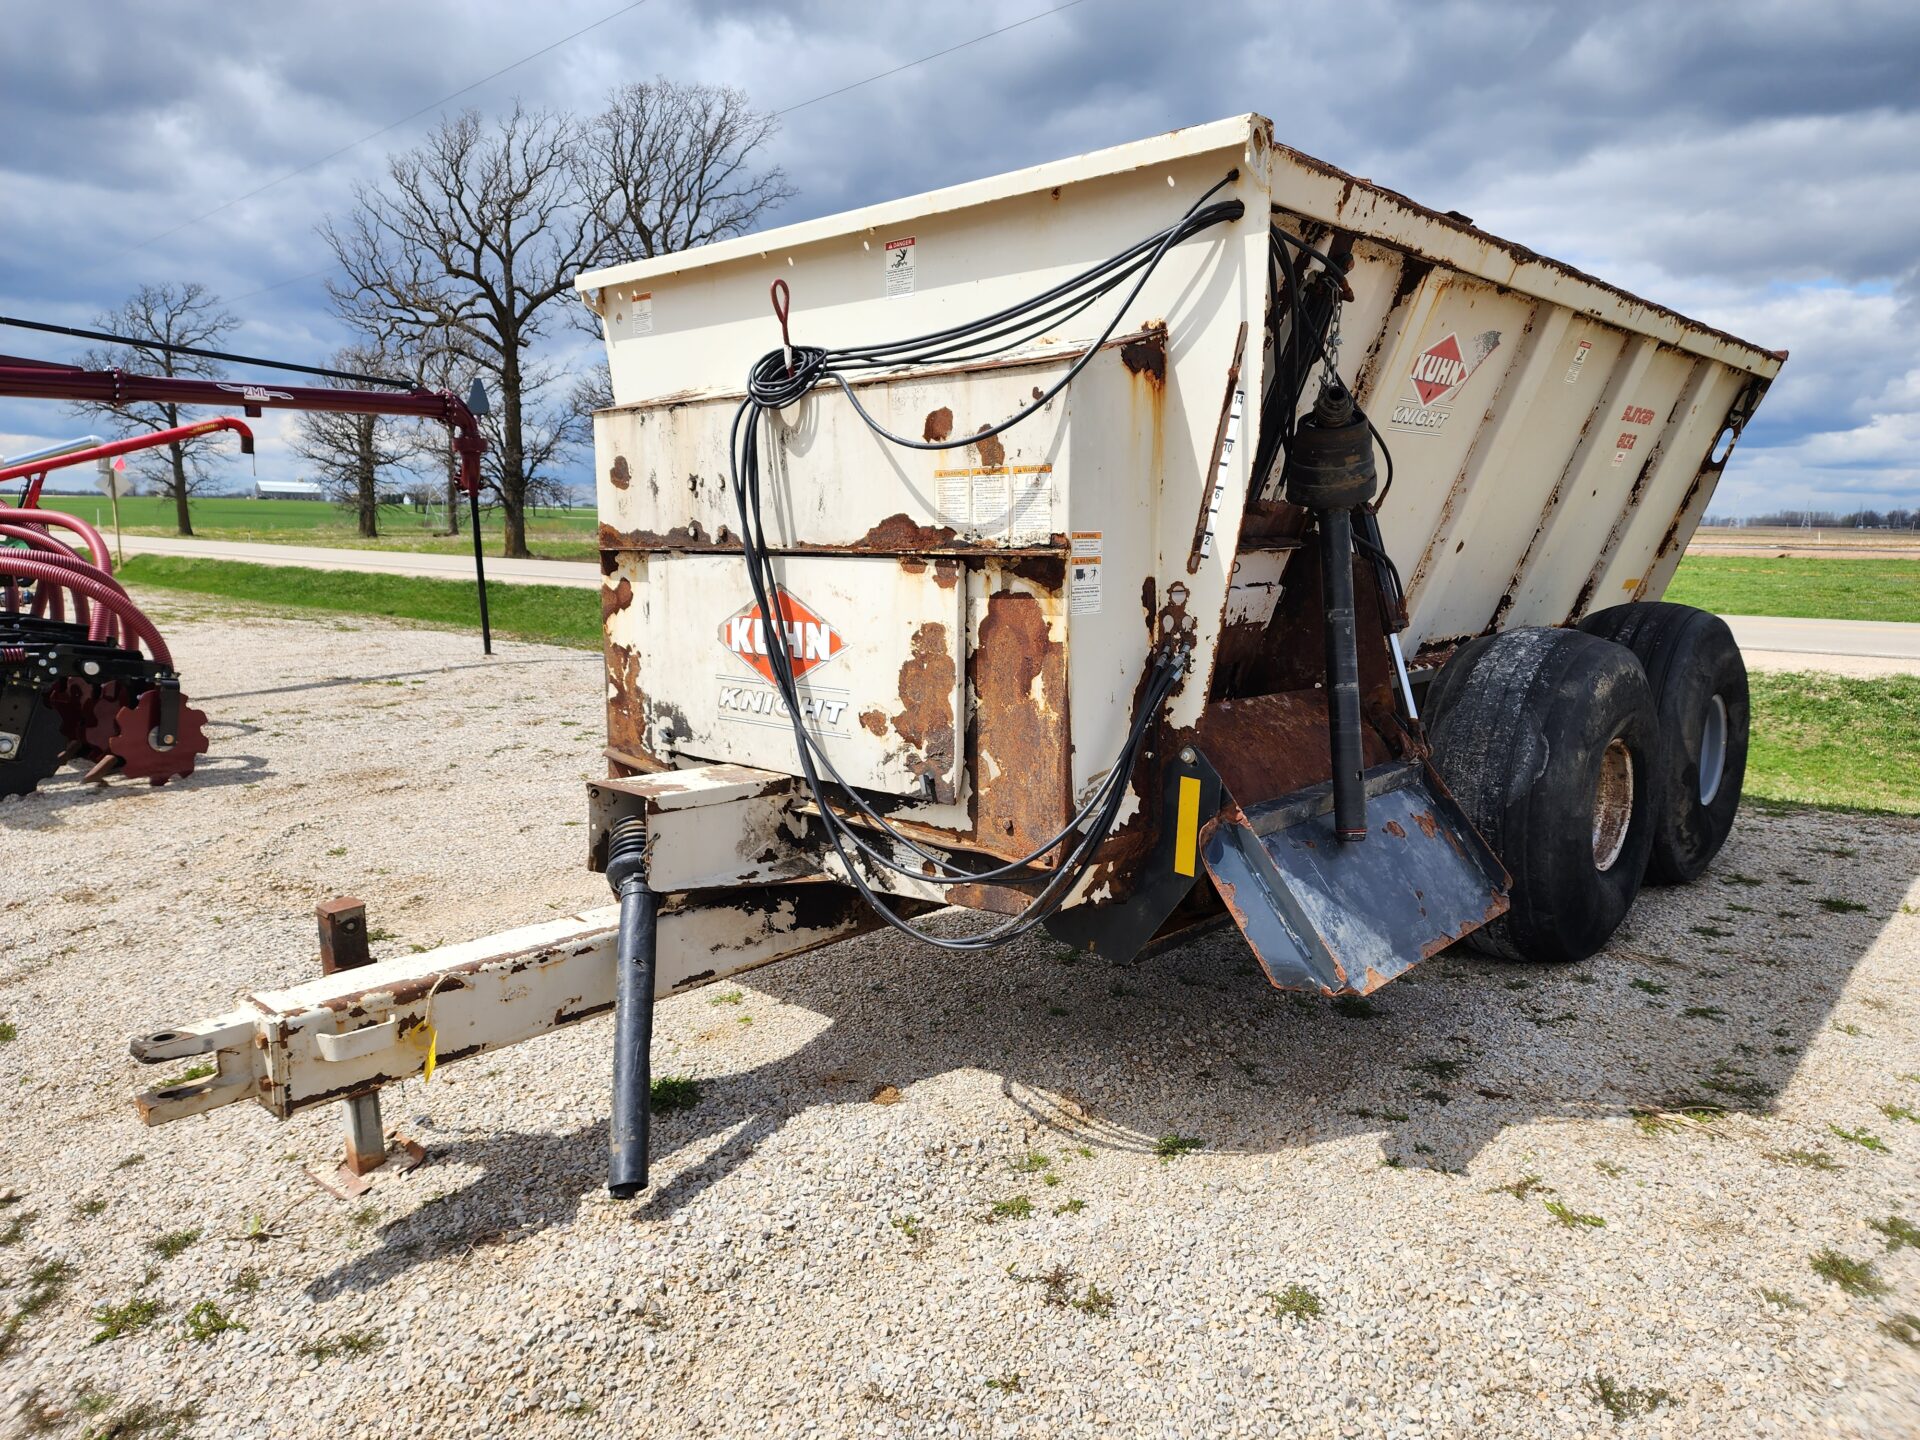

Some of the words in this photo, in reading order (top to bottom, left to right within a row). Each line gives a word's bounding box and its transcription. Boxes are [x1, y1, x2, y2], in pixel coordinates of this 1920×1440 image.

[893, 239, 912, 248] DANGER
[1411, 353, 1464, 387] KUHN
[245, 387, 268, 397] ZML
[1234, 395, 1244, 405] 14
[1392, 406, 1450, 428] KNIGHT
[1224, 443, 1233, 453] 10
[1214, 490, 1220, 499] 6
[1204, 535, 1210, 545] 2
[731, 617, 830, 661] KUHN
[718, 686, 848, 725] KNIGHT
